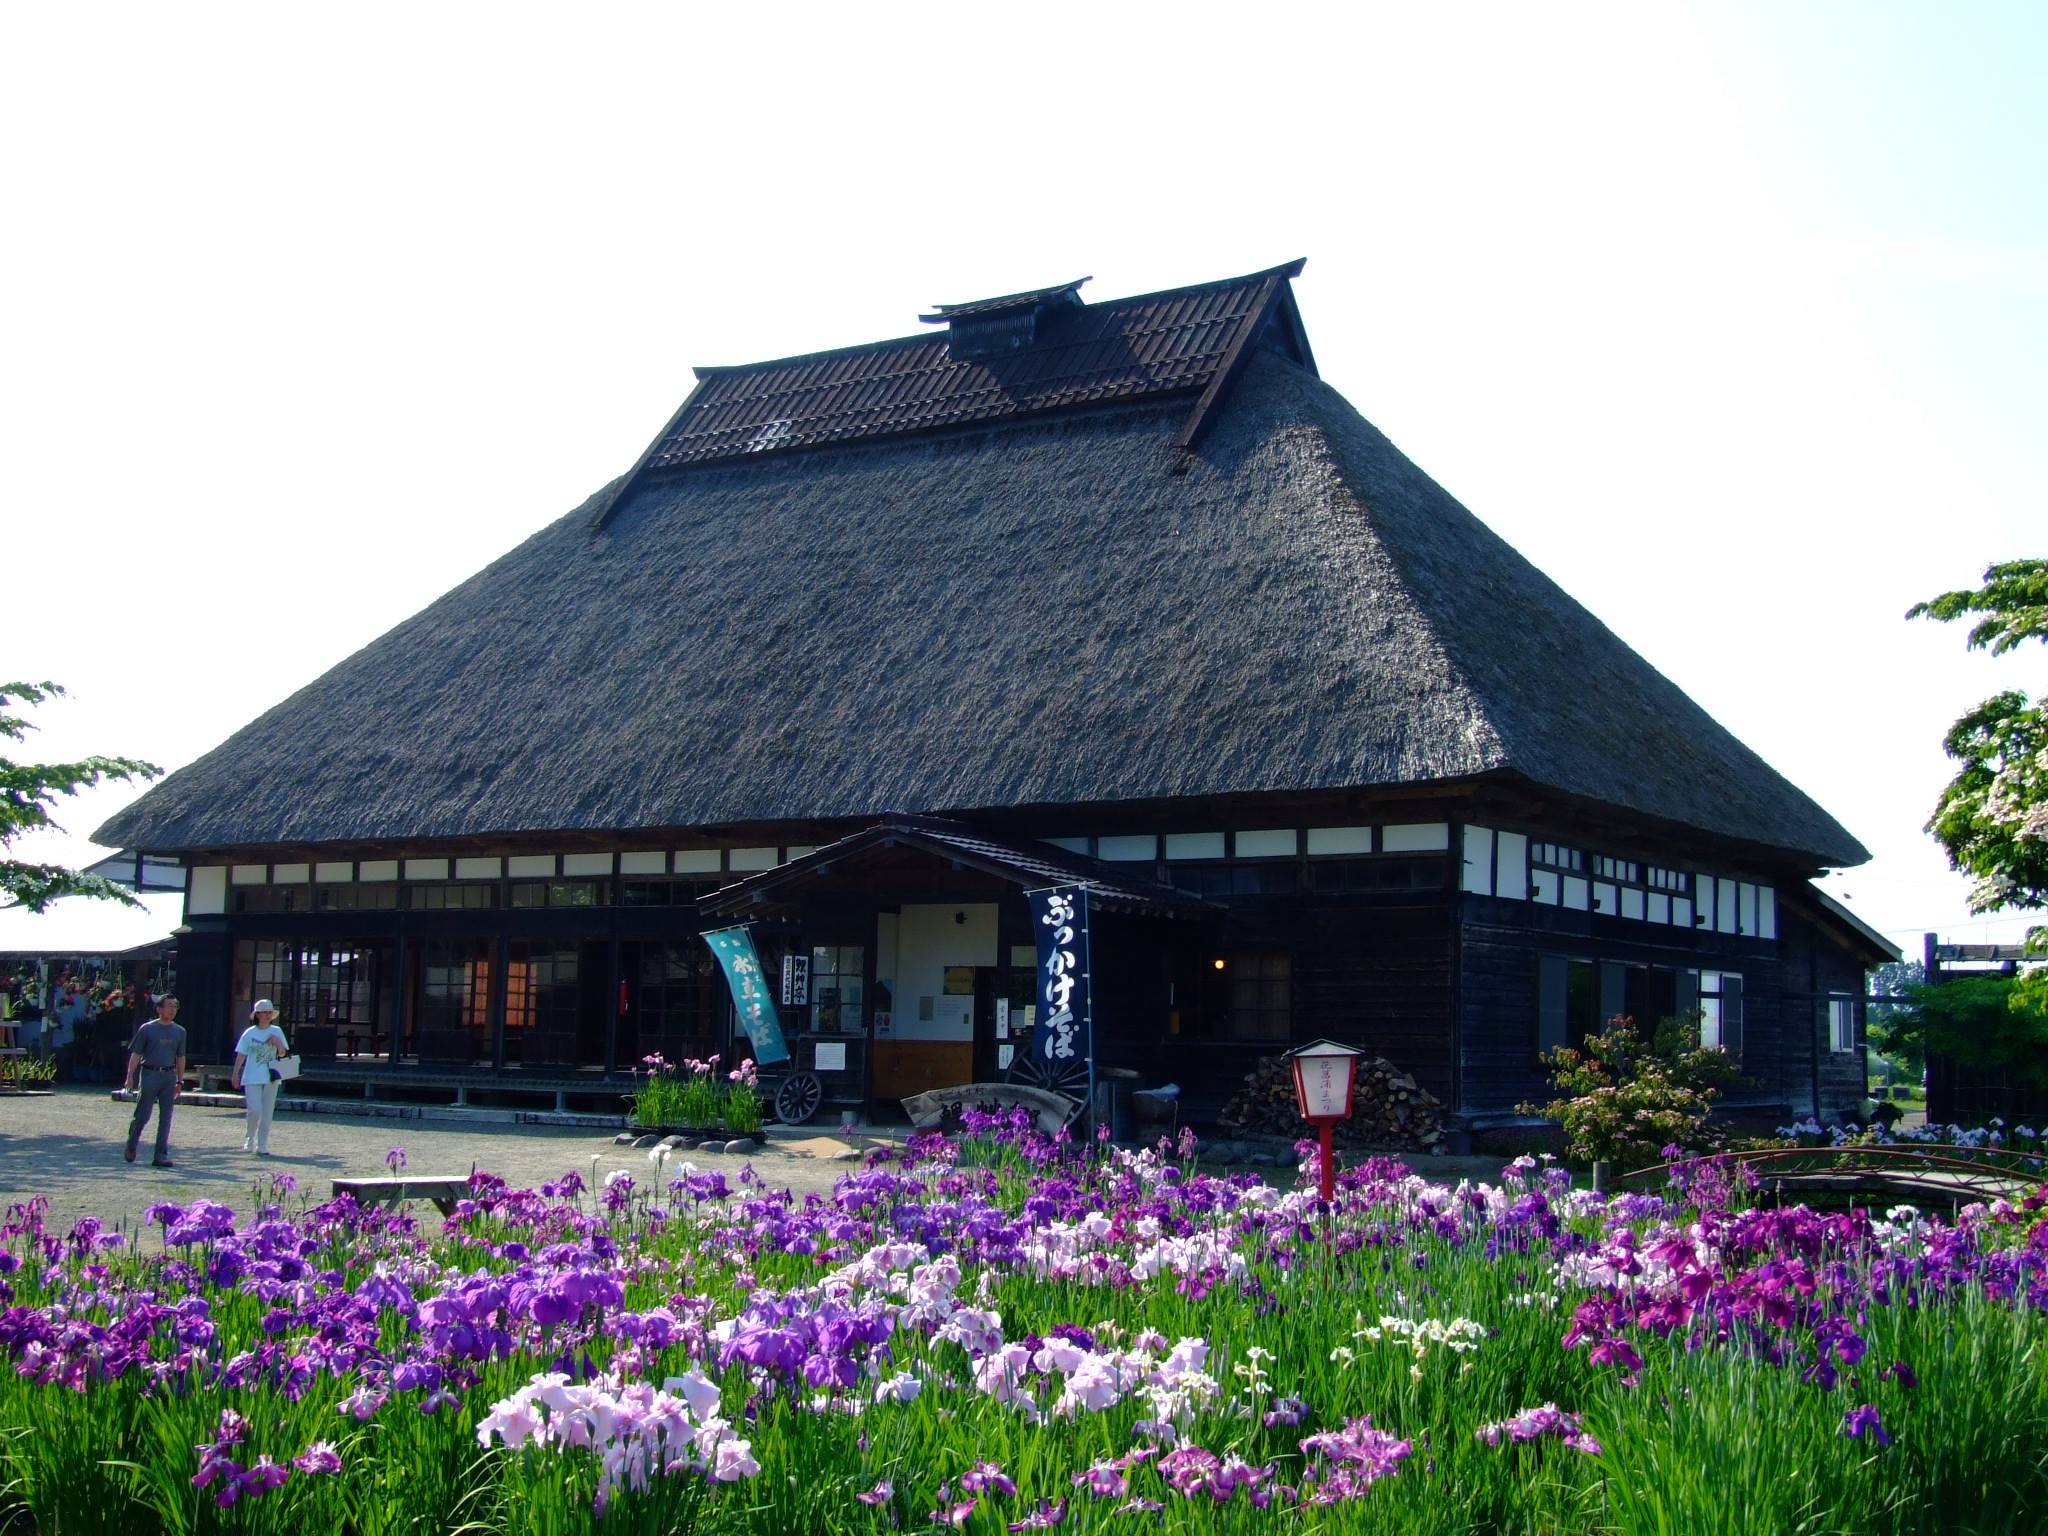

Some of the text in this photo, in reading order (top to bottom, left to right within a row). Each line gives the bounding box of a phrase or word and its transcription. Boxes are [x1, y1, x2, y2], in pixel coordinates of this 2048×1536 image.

[1042, 894, 1080, 1059] ぶっかけそば
